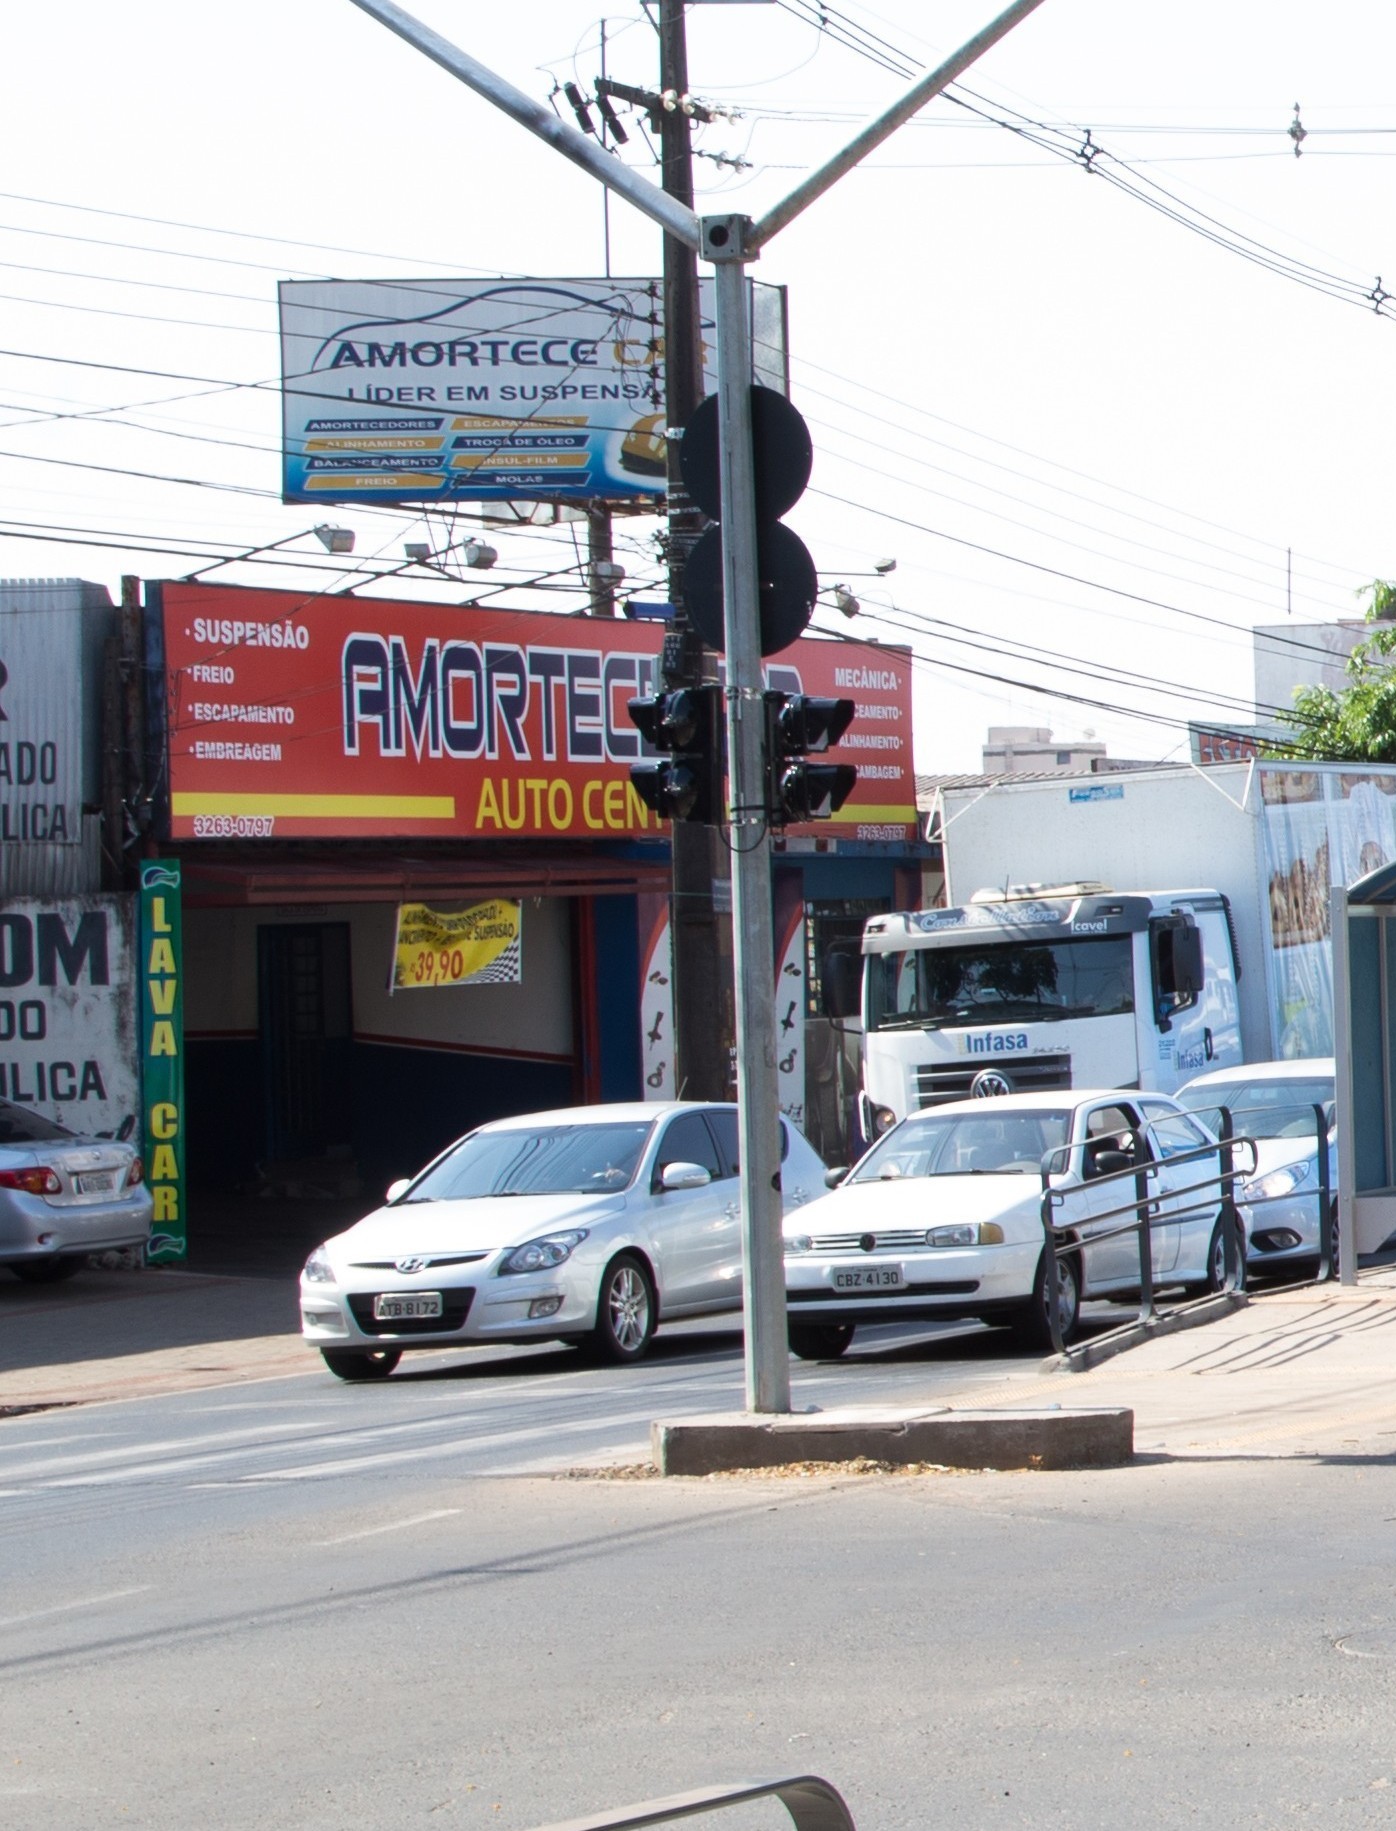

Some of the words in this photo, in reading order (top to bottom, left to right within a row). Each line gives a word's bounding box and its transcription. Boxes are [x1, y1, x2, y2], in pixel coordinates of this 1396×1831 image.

[329, 339, 598, 369] AMORTECE
[348, 382, 434, 403] LÍDER
[446, 385, 489, 402] EM
[310, 420, 436, 431] AMORTECEDORES
[327, 440, 426, 449] ALINHAMENTO
[464, 437, 512, 447] TROCA
[514, 437, 534, 446] DE
[537, 436, 575, 446] ÓLEO
[355, 477, 398, 486] FREIO
[495, 474, 544, 484] MOLAS
[193, 617, 310, 650] SUSPENSÃO
[193, 665, 235, 685] FREIO
[834, 665, 898, 691] MECÂNICA
[193, 702, 295, 724] ESCAPAMENTO
[194, 741, 282, 762] EMBREAGEM
[475, 777, 574, 831] AUTO
[1, 804, 69, 841] LICA
[193, 814, 275, 838] 3263-0797
[148, 896, 178, 1057] LAVA
[415, 949, 464, 987] 39,90
[966, 1031, 1028, 1054] Infasa
[150, 1101, 180, 1222] CAR
